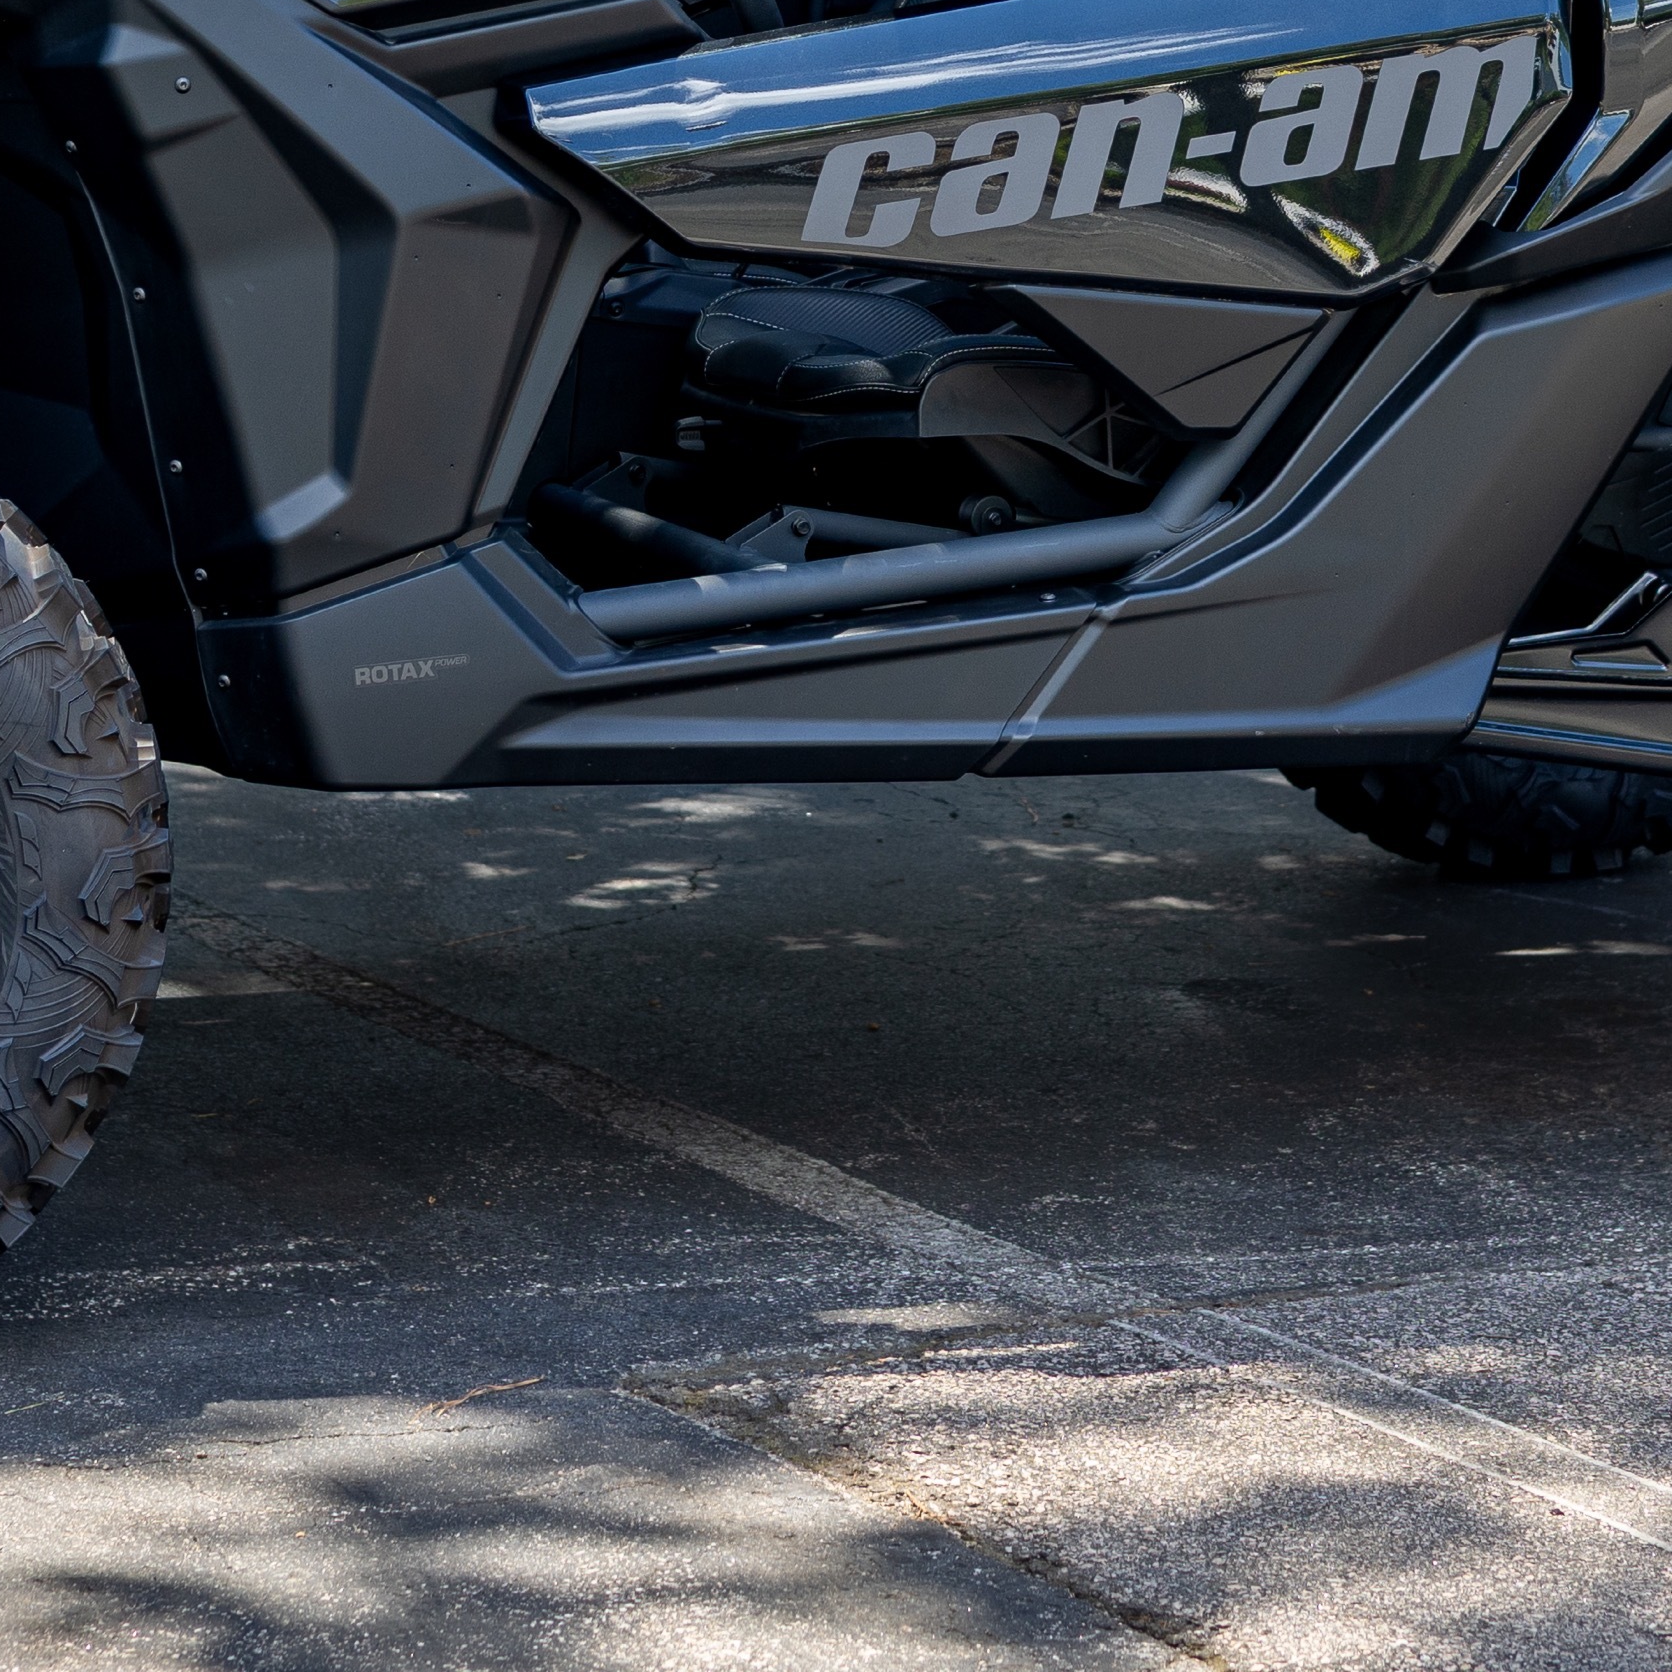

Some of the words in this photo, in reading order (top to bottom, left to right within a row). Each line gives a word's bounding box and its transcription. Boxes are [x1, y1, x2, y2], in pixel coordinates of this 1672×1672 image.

[801, 35, 1539, 248] can-am
[355, 660, 435, 686] ROTAX
[435, 656, 467, 667] POWER
